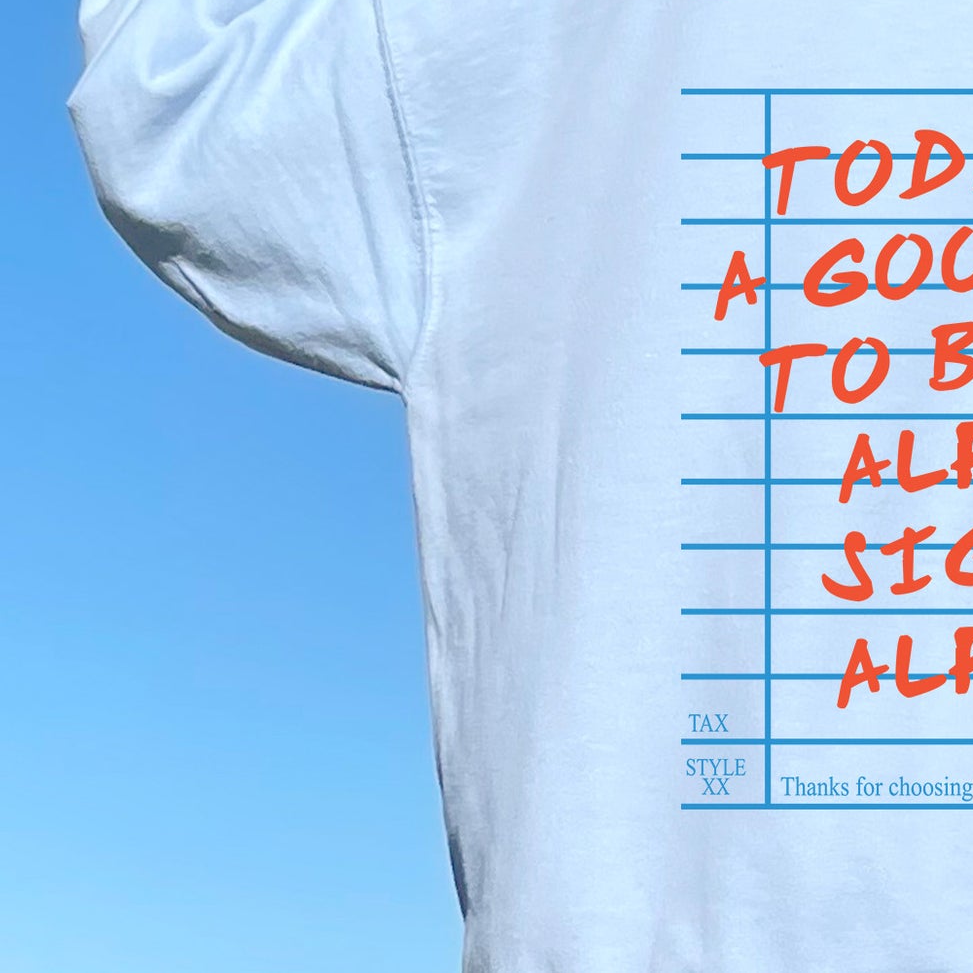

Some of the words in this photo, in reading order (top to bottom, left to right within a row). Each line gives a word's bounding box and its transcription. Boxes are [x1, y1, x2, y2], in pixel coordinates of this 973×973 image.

[714, 250, 767, 322] A
[758, 336, 891, 414] TO
[688, 713, 730, 734] TAX
[685, 757, 747, 777] STYLE
[701, 777, 731, 796] XX
[780, 775, 851, 798] Thanks
[855, 774, 884, 798] for
[888, 775, 973, 803] choosing
